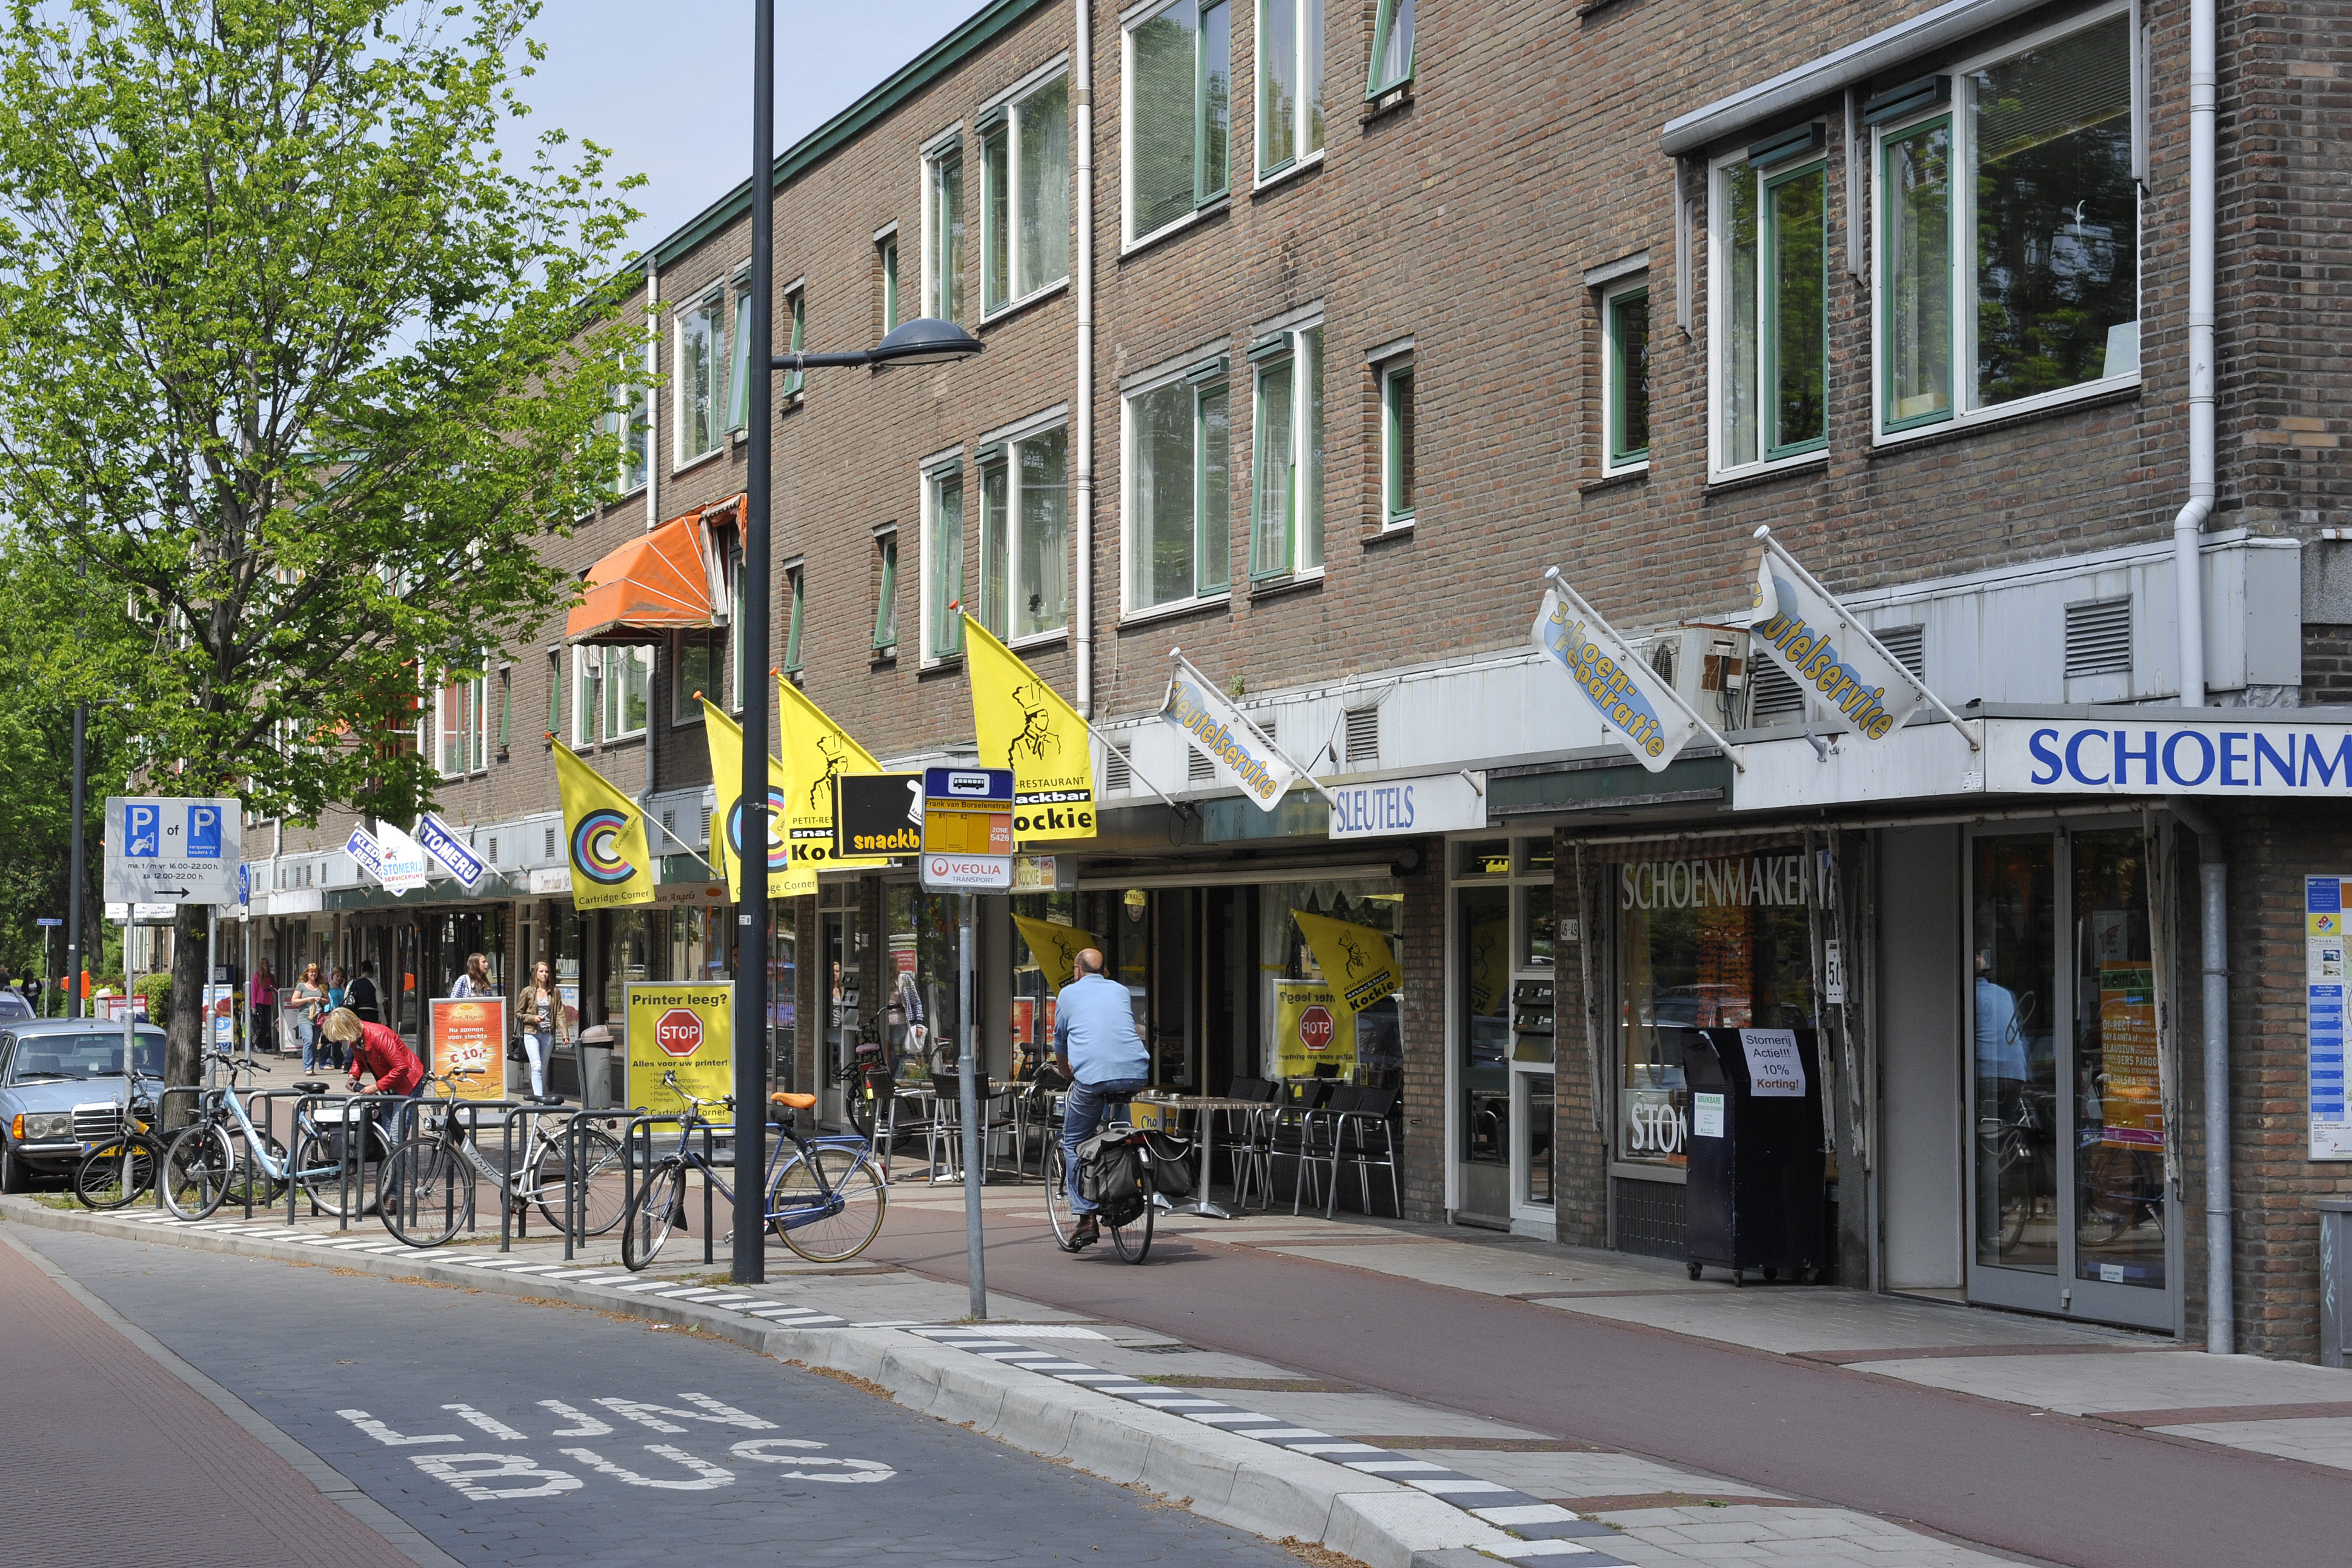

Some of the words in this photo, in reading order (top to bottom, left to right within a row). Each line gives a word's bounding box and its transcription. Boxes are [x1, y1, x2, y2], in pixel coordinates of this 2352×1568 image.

[1549, 601, 1636, 696] Schoen-
[1753, 611, 1893, 741] utelservice
[1553, 633, 1665, 757] reparatie
[1168, 680, 1277, 800] Sleutelservice
[1015, 777, 1085, 788] -RESTAURANT
[1015, 791, 1089, 804] ackbar
[1337, 785, 1414, 832] SLEUTELS
[131, 808, 153, 836] P
[194, 808, 215, 837] P
[792, 816, 834, 825] PETIT-RES
[1014, 808, 1092, 831] ockie
[167, 825, 179, 835] of
[792, 829, 834, 839] snac
[854, 828, 920, 850] snackb
[419, 822, 479, 880] STOMERIJ
[382, 861, 422, 876] STOMERIJ
[951, 863, 1001, 875] VEOLIA
[384, 873, 424, 882] SERVICEPUNT
[1018, 869, 1039, 886] KOCKIE
[784, 880, 816, 890] Corner
[579, 893, 619, 905] Cartridge
[621, 890, 649, 900] Corner
[666, 891, 696, 903] Angels
[1343, 966, 1386, 991] PETIT-RESTAURANT
[1346, 972, 1389, 998] snackbar
[632, 994, 683, 1005] Printer
[688, 994, 728, 1007] leeg?
[1349, 982, 1395, 1011] Kockie
[2102, 1019, 2131, 1032] DI-RECT
[661, 1026, 699, 1040] STOP
[2102, 1032, 2113, 1041] RAY
[2117, 1033, 2132, 1042] ANITA
[2133, 1034, 2138, 1042] of
[1746, 1035, 1792, 1047] Stomerij
[1753, 1048, 1790, 1058] Actie!!!
[2102, 1043, 2135, 1054] BLAUDZUN
[450, 1054, 459, 1063] €
[695, 1060, 728, 1069] printer!
[2116, 1055, 2133, 1065] GERS
[2135, 1056, 2159, 1067] PARDO
[1762, 1065, 1790, 1075] 10%
[1757, 1078, 1799, 1091] Korting!
[335, 1392, 780, 1446] LIJN
[407, 1437, 897, 1501] BUS
